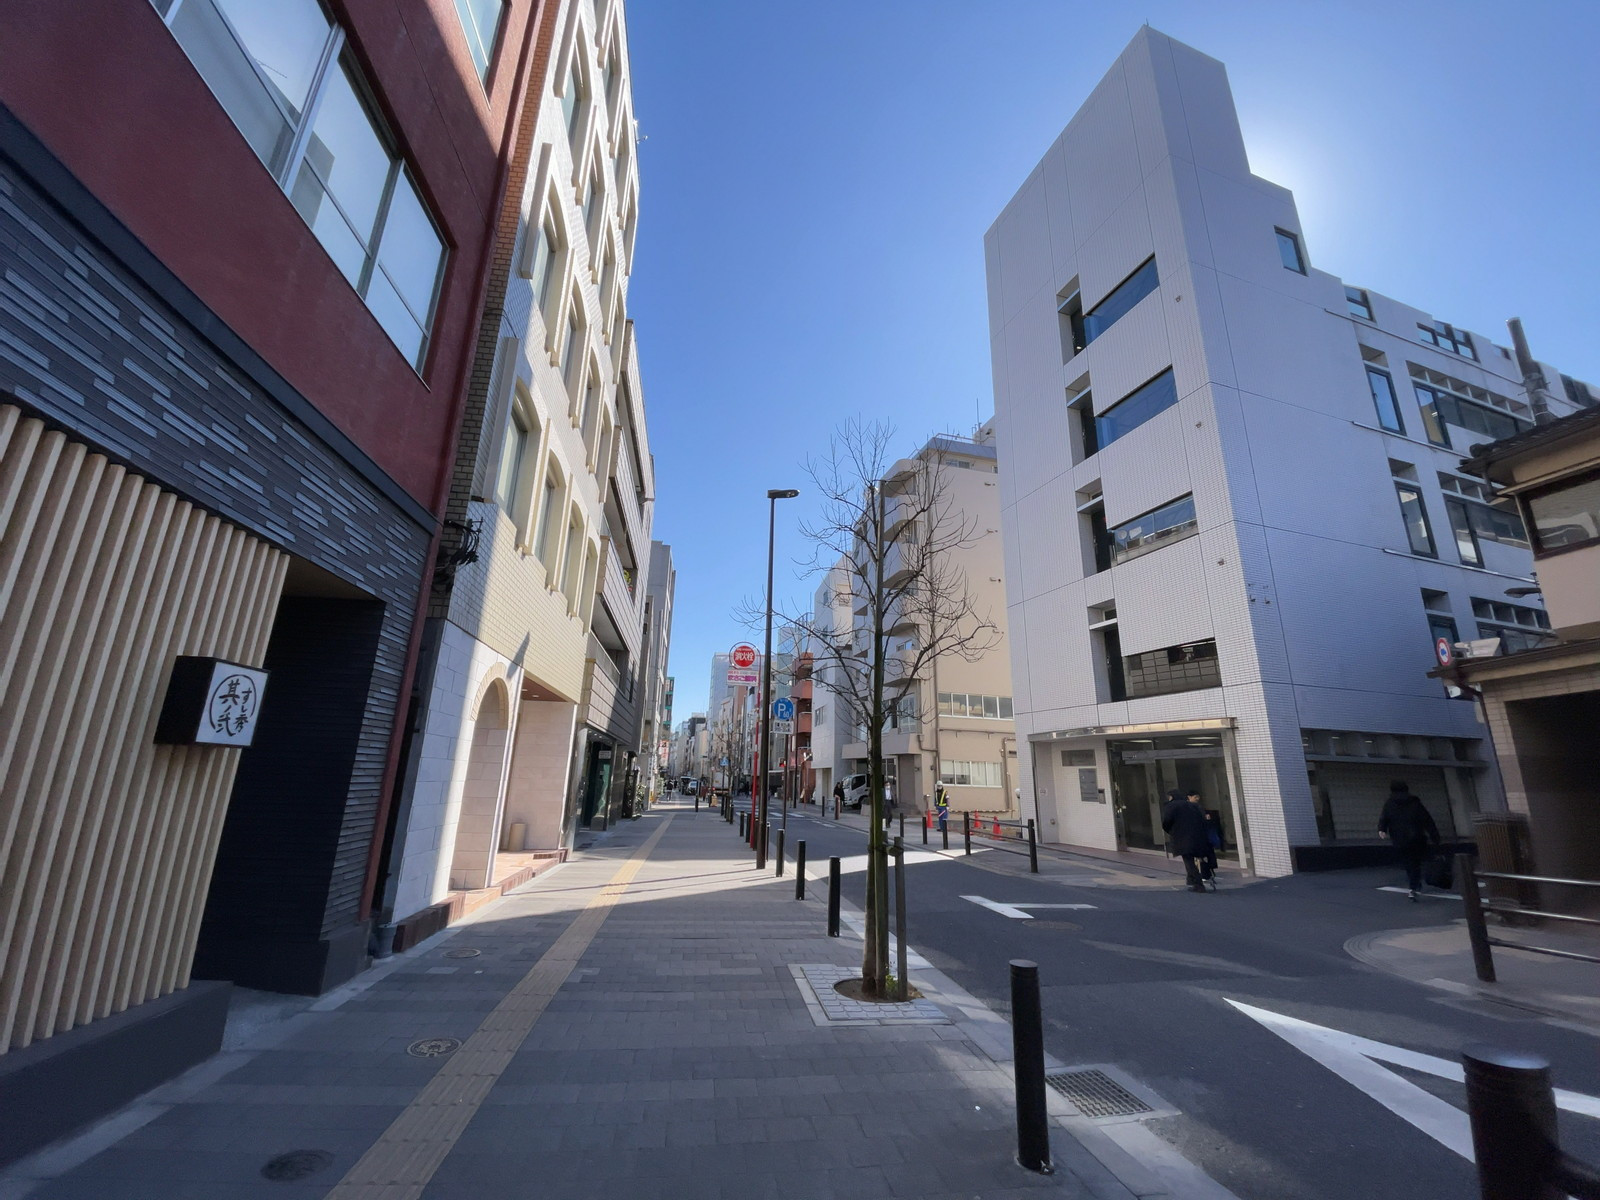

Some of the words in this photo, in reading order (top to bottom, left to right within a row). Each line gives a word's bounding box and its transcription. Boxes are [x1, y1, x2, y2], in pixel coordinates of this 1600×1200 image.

[735, 652, 754, 661] 消火栓
[233, 687, 252, 733] すし秀
[778, 703, 786, 717] P
